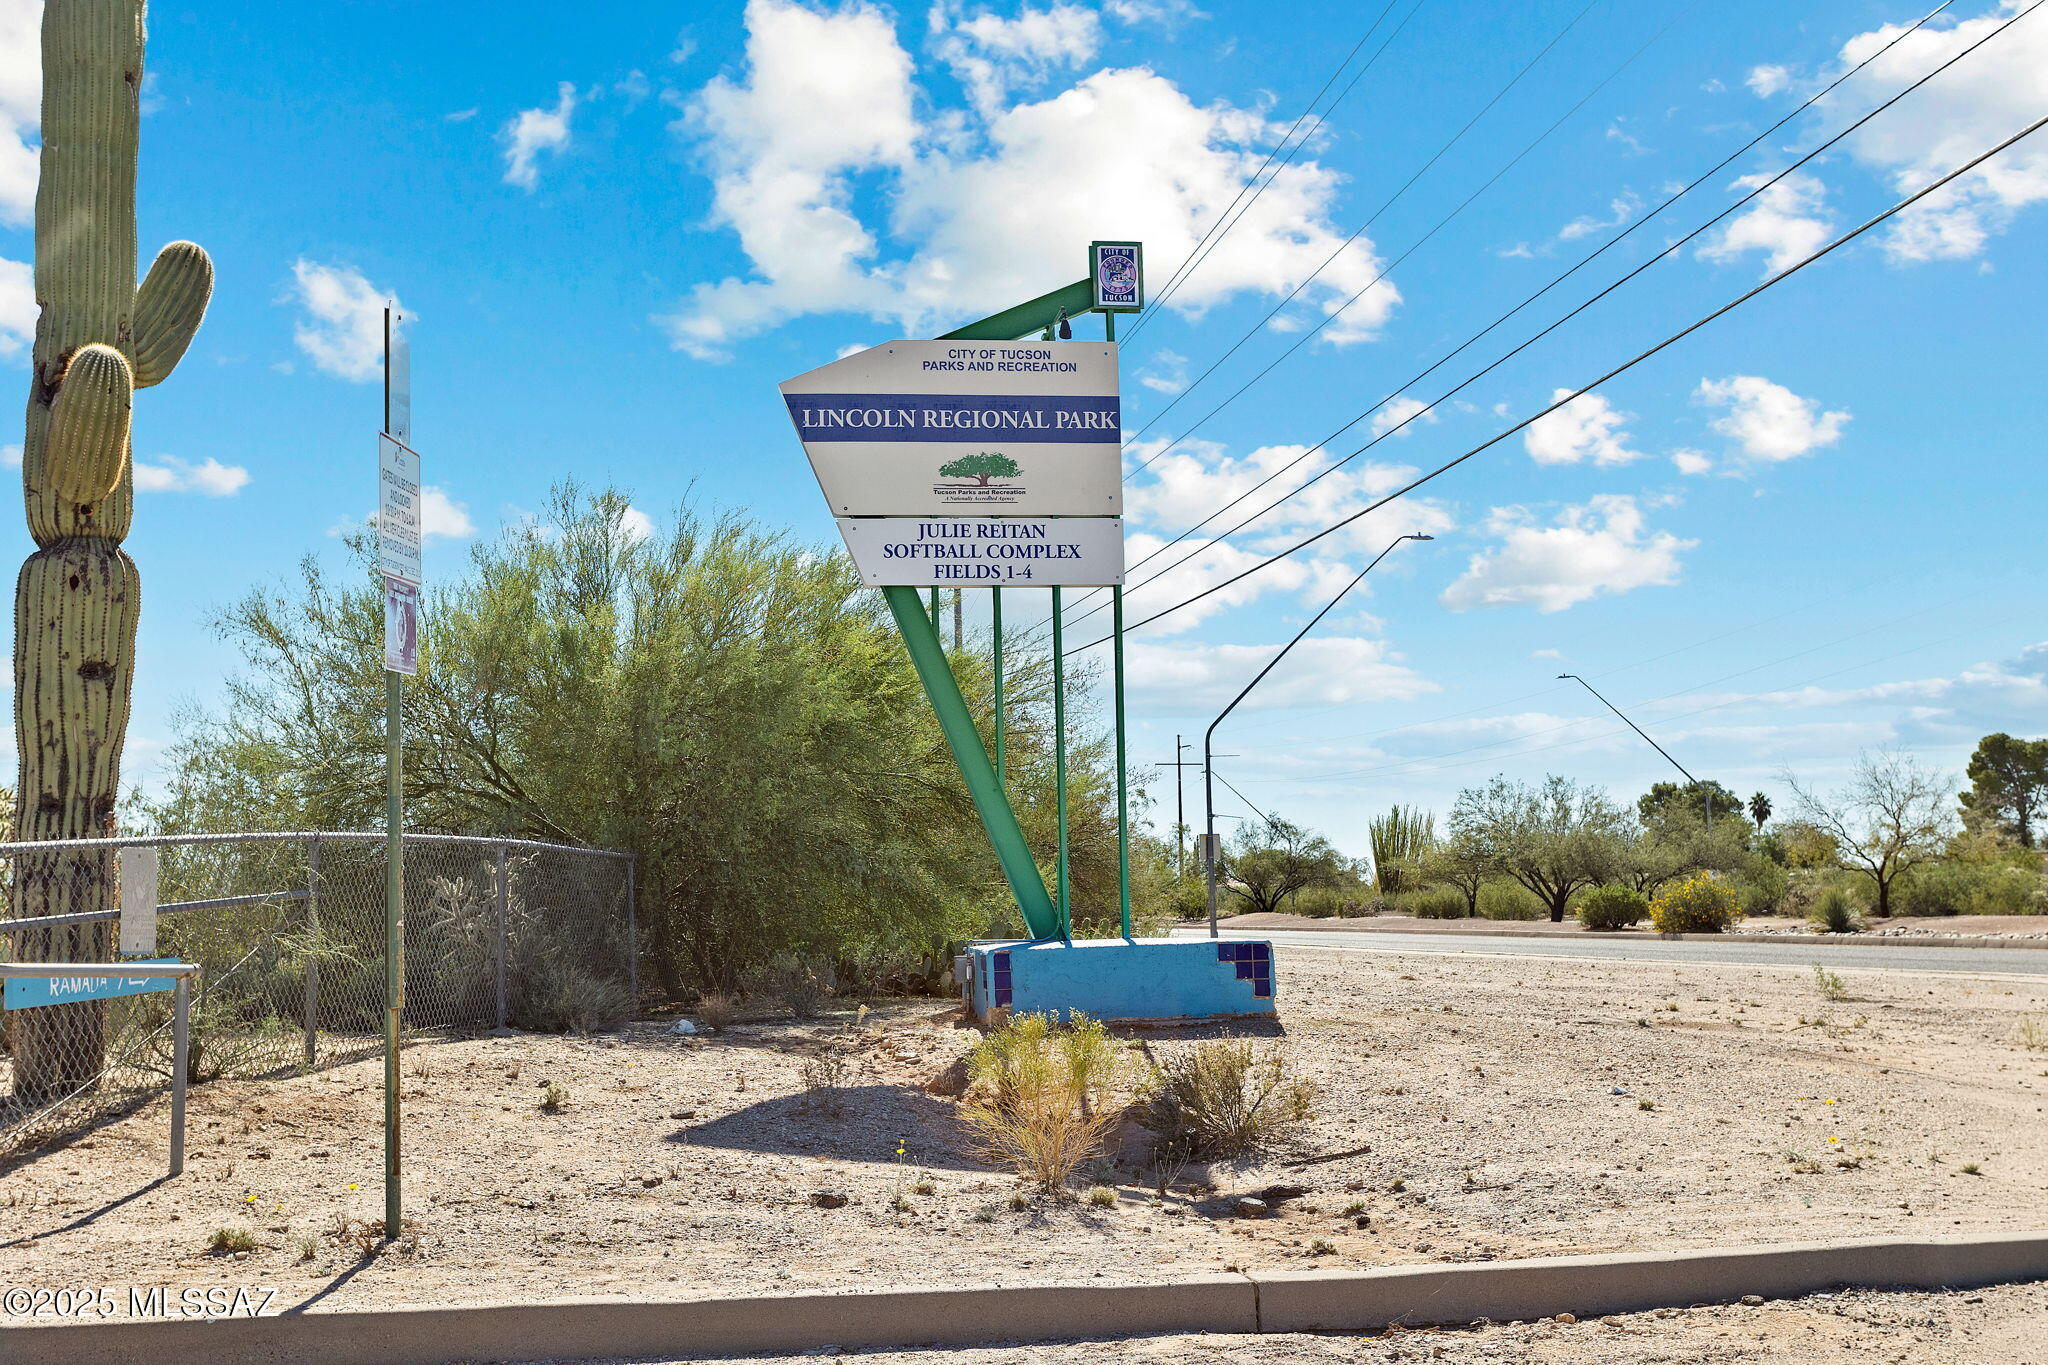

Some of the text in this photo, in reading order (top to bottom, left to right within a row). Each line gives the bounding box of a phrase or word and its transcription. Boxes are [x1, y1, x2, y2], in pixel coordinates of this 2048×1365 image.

[1104, 248, 1119, 256] CITY
[1104, 294, 1133, 302] TUCSON
[948, 349, 1051, 360] CITY OF TUCSON
[922, 361, 1077, 372] PARKS AND RECREATION
[802, 409, 1118, 429] LINCOLN REGIONAL PARK
[917, 523, 1046, 541] JULIE REITAN
[883, 543, 1082, 559] SOFTBALL COMPLEX
[934, 563, 1033, 580] FIELDS 1-4
